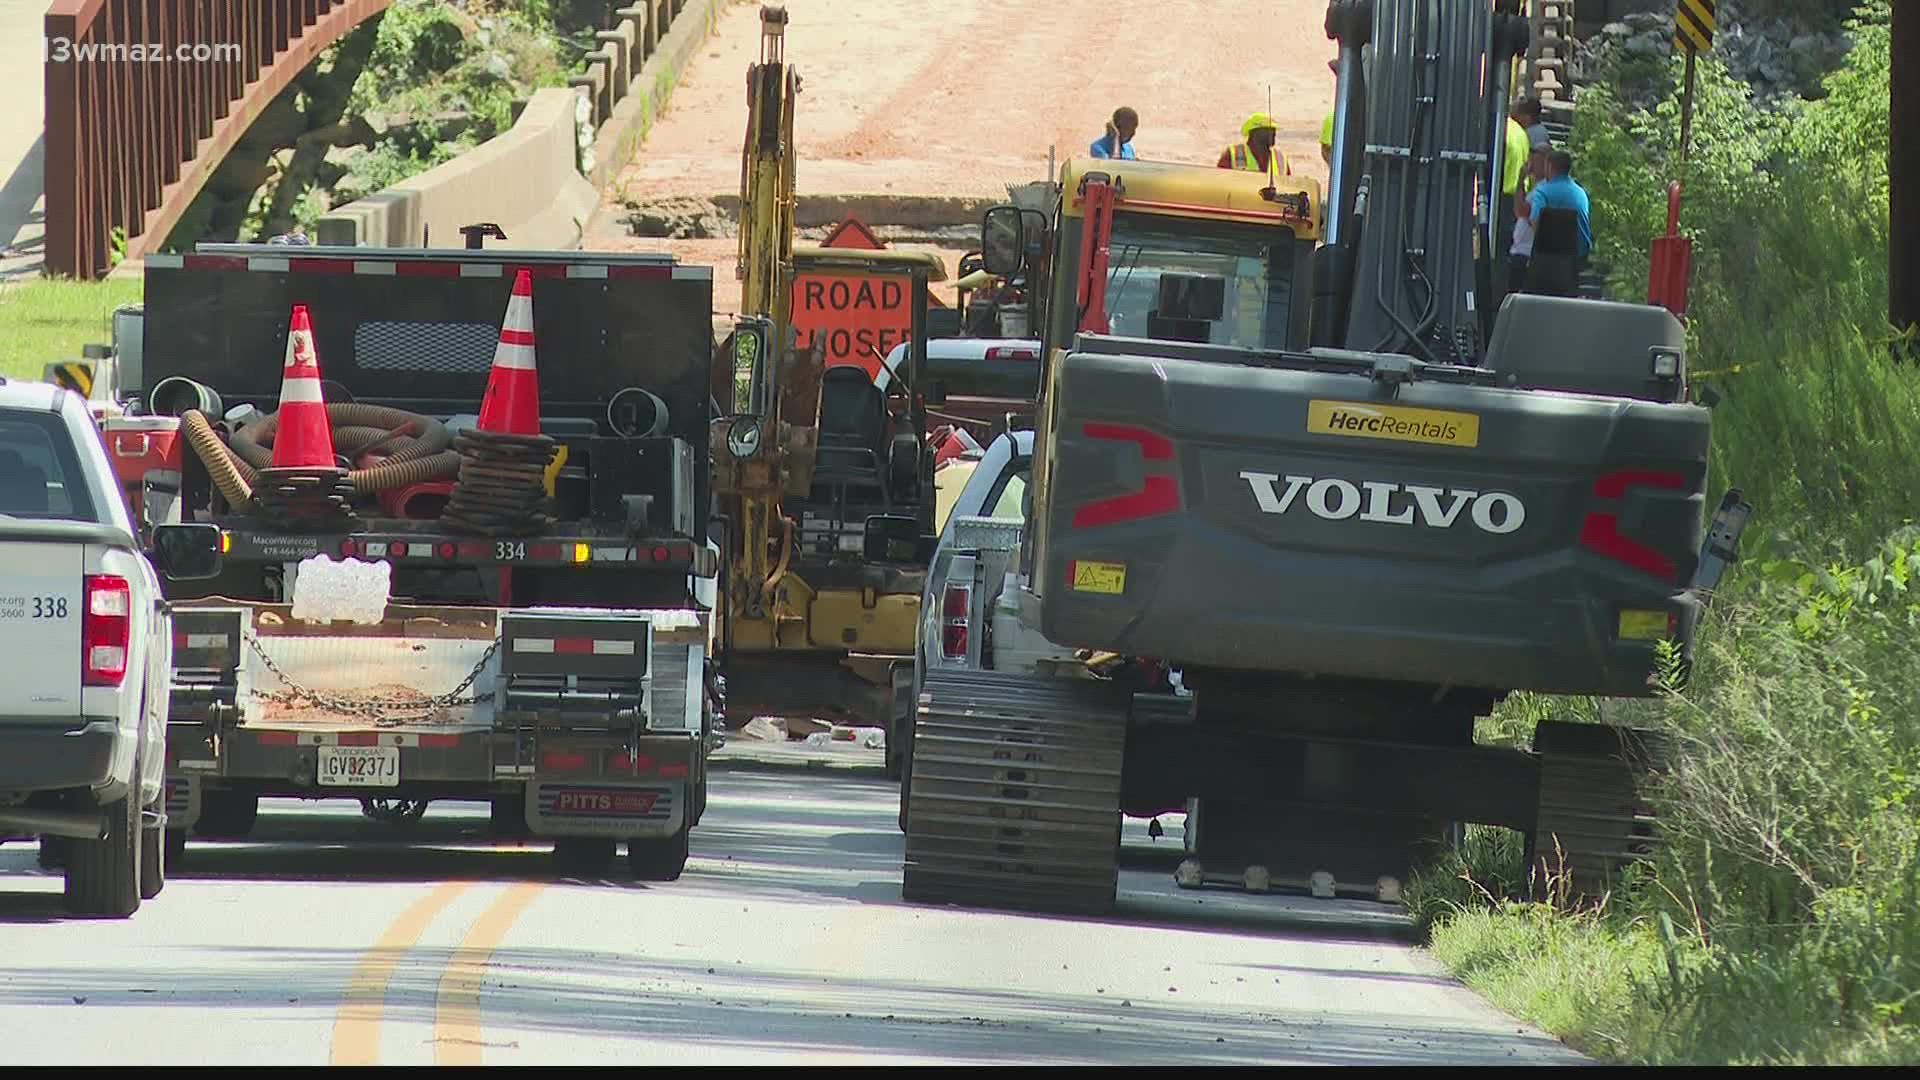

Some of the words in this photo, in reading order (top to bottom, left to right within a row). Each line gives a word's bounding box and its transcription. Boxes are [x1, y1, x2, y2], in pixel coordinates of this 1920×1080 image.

[806, 280, 902, 310] ROAD
[1328, 411, 1457, 440] HercRentals
[1240, 471, 1525, 533] VOLVO
[496, 542, 525, 560] 334
[32, 597, 68, 618] 338
[560, 793, 611, 809] PITTS
